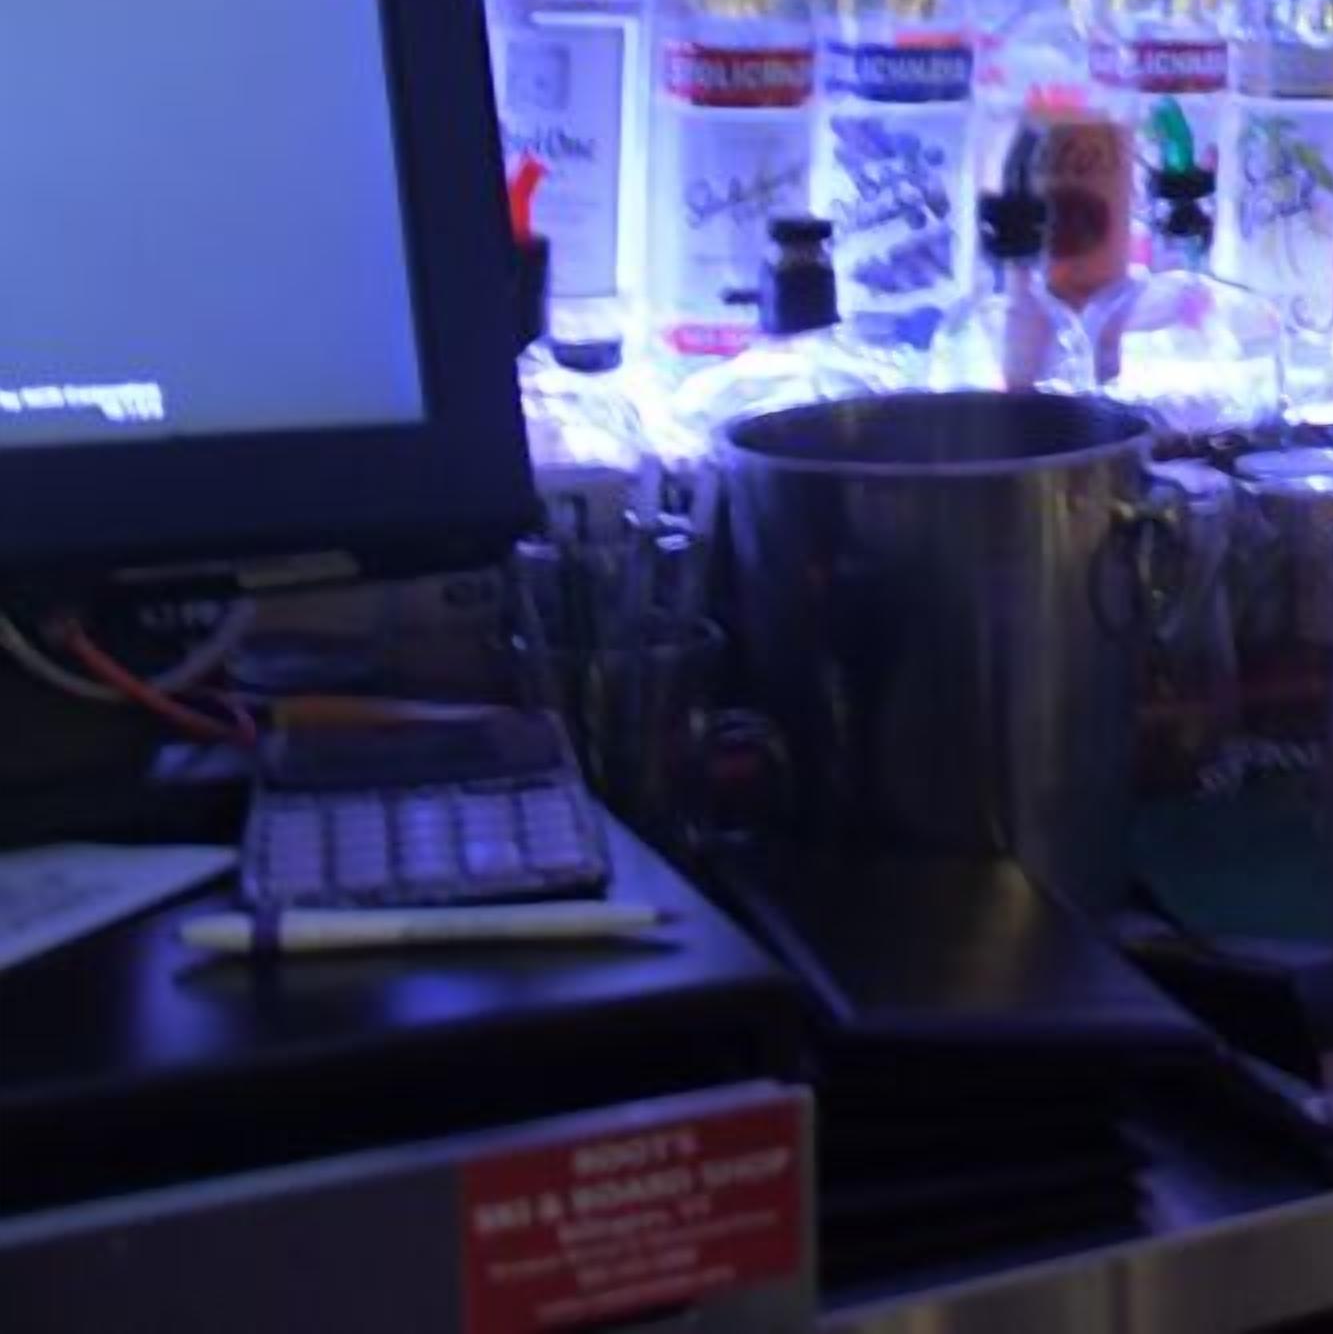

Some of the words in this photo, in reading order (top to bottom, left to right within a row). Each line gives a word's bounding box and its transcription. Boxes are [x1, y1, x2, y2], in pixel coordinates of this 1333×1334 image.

[471, 1193, 531, 1235] SKI
[570, 1167, 694, 1216] BOARD
[700, 1145, 792, 1190] SHOP
